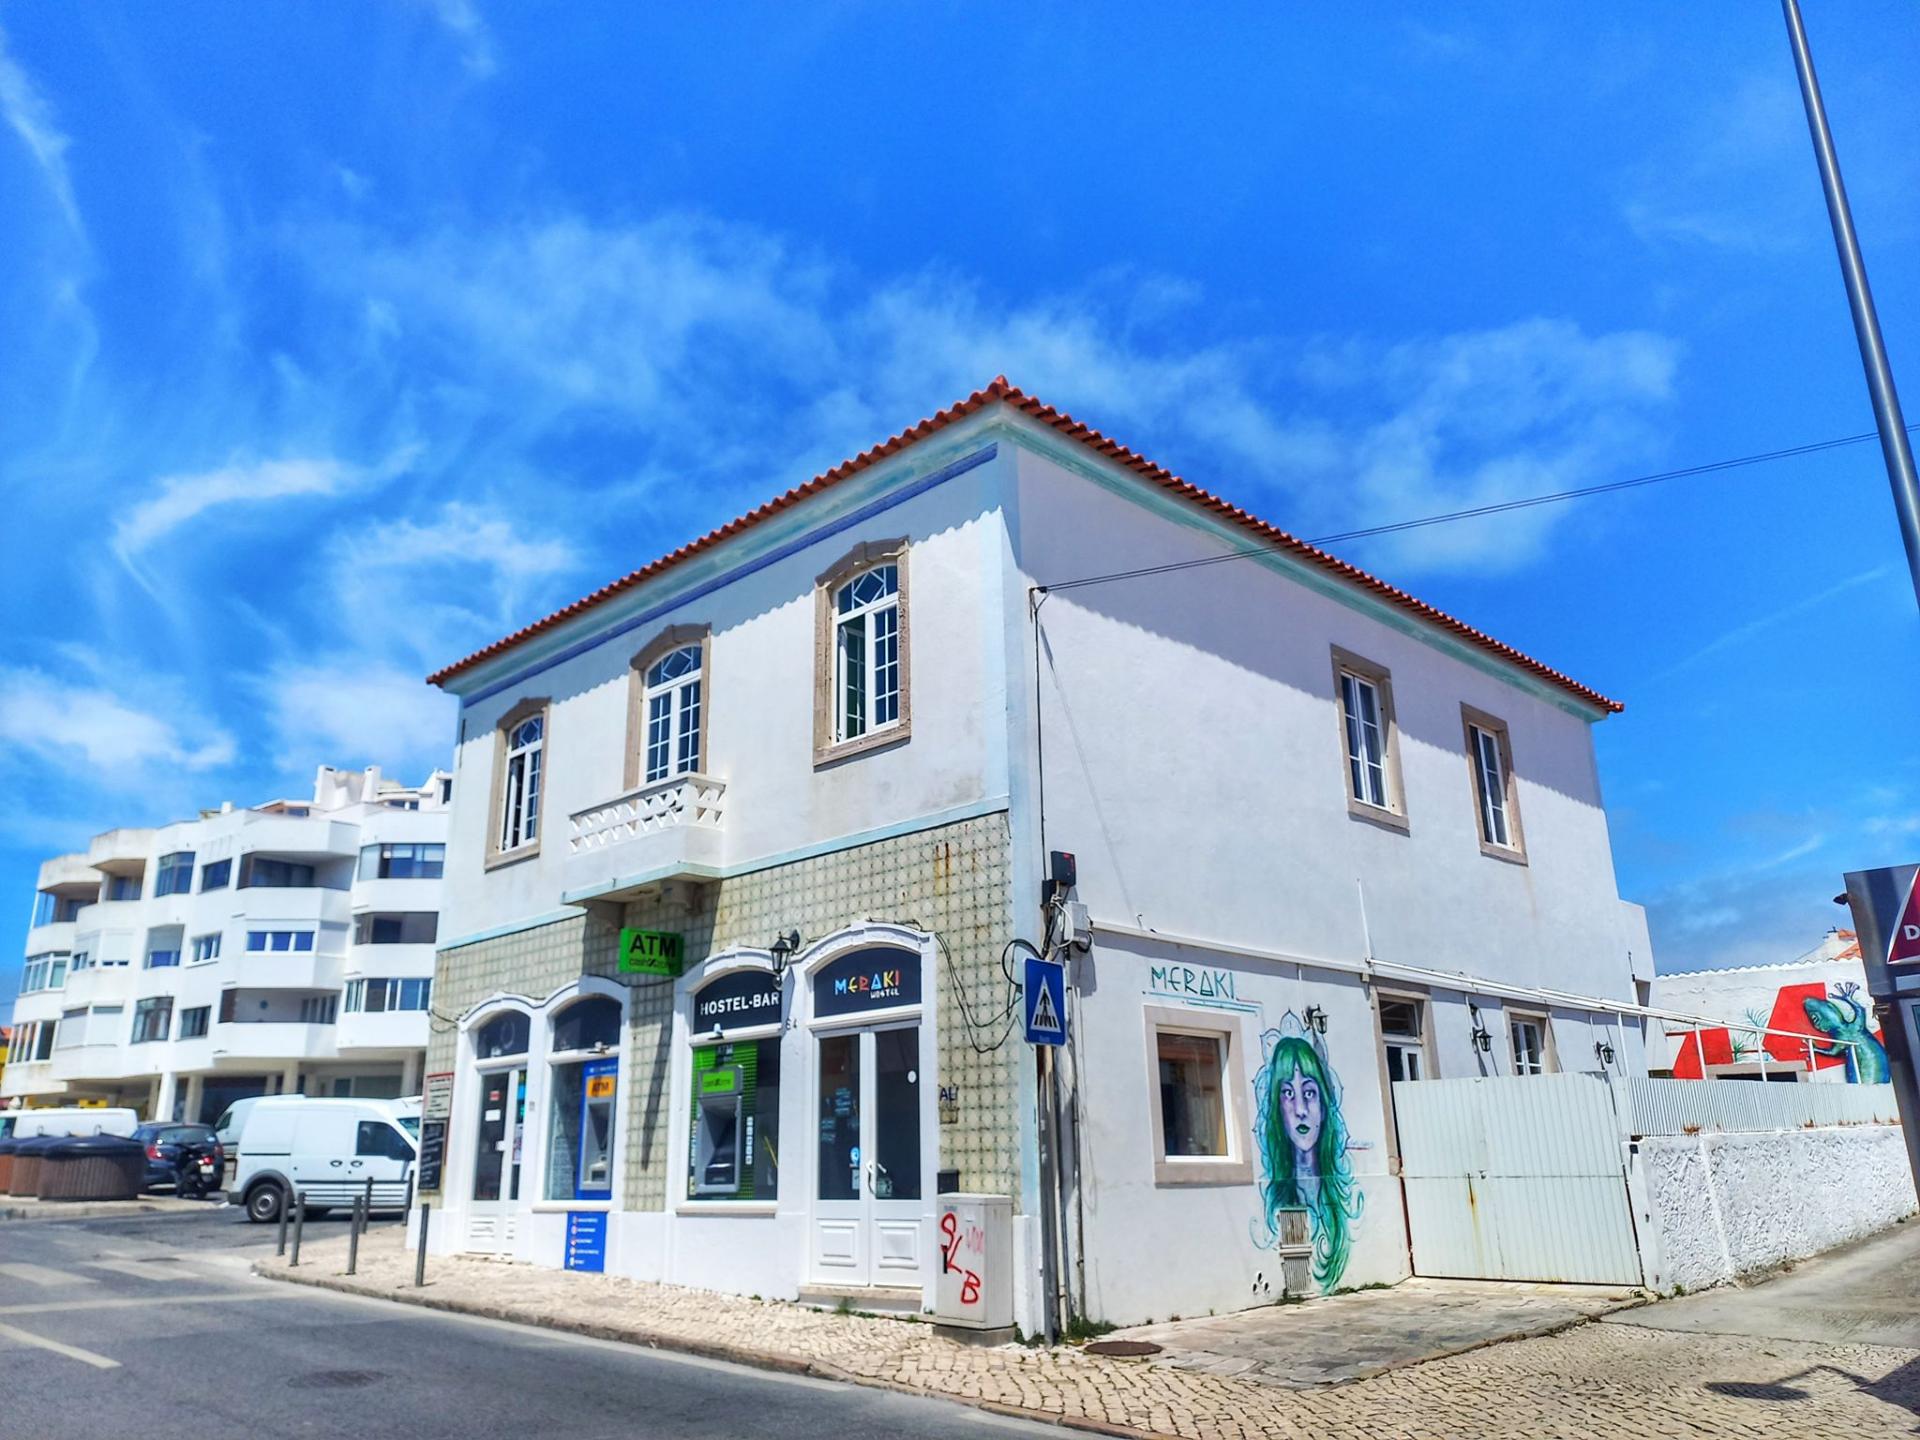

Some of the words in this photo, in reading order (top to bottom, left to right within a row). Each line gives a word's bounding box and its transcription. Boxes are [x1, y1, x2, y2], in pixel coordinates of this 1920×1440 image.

[629, 934, 676, 957] ATM
[834, 970, 899, 995] MERAKI
[1150, 966, 1235, 999] MERAKI
